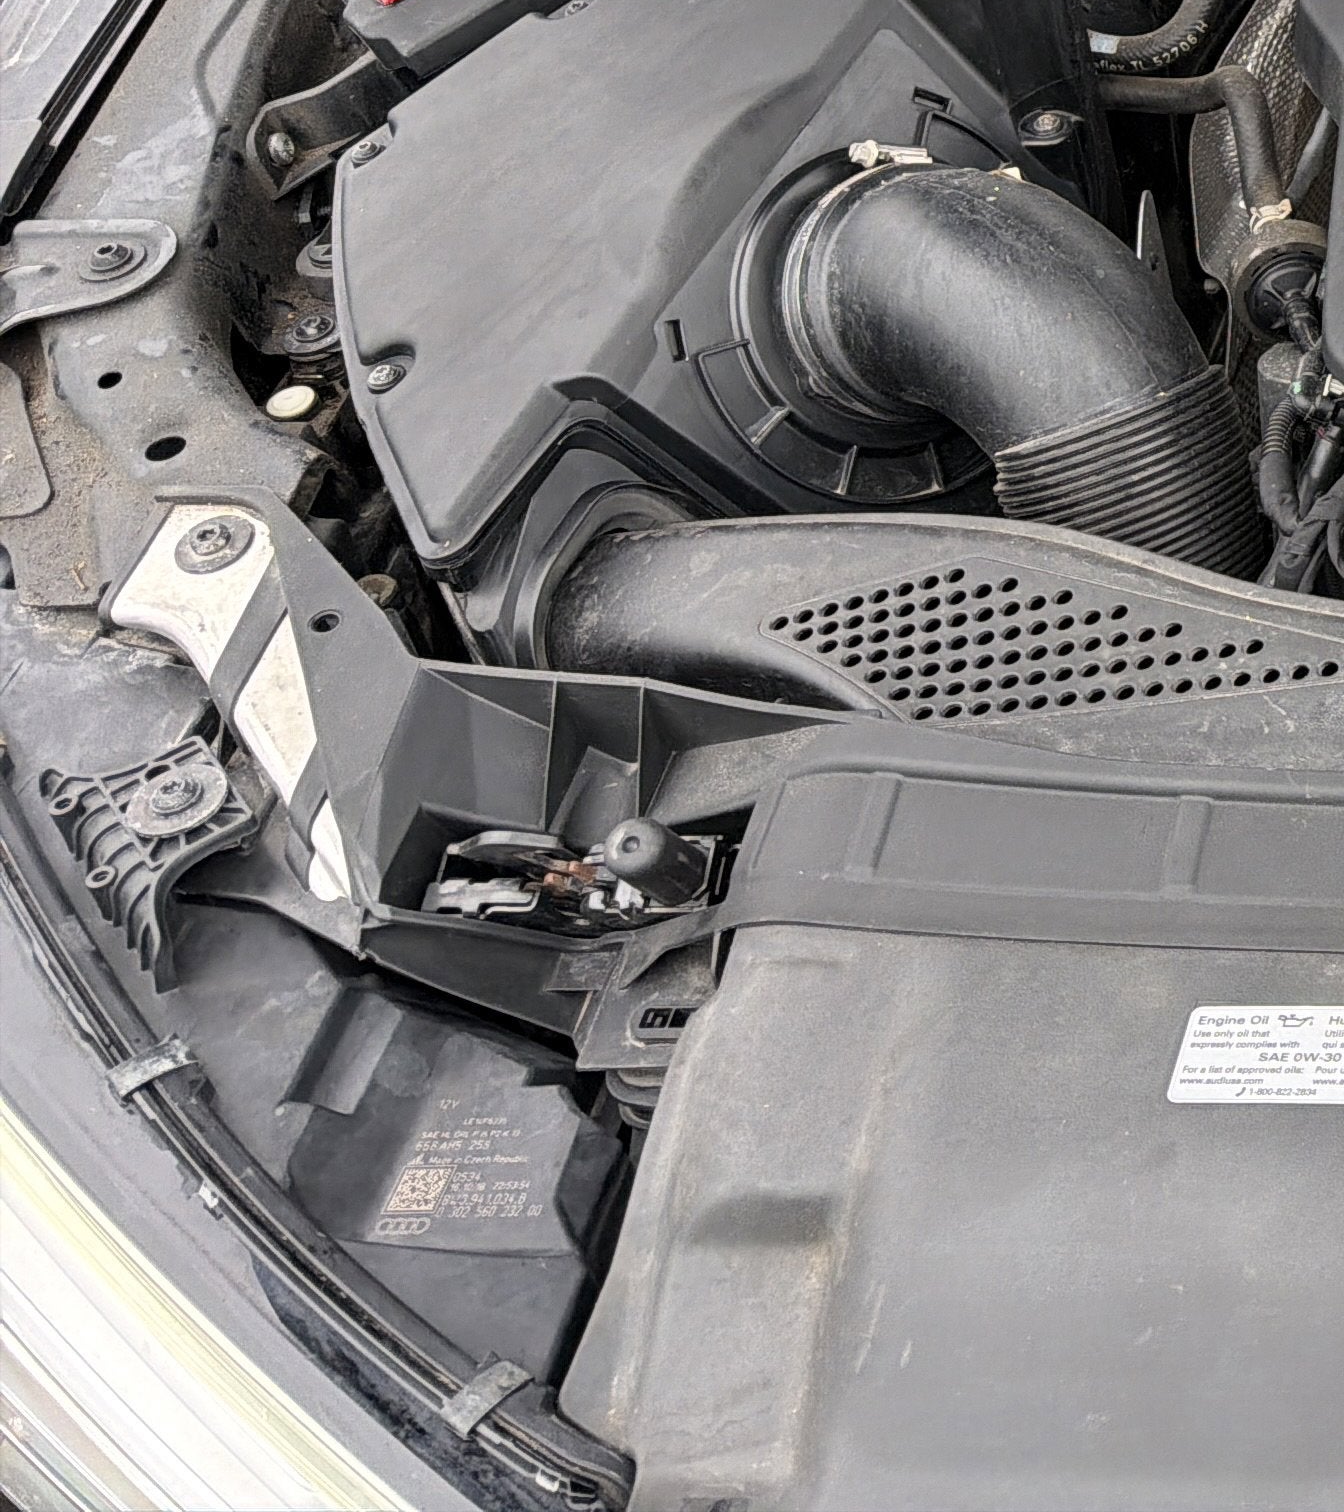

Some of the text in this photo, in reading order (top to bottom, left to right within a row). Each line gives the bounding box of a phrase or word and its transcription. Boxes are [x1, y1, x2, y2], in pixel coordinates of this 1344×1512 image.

[1152, 34, 1198, 67] 52706
[1198, 1015, 1270, 1027] Engine Oil
[1193, 1029, 1271, 1040] Use only oil that
[1190, 1040, 1300, 1050] expressly complies with
[1322, 1041, 1338, 1050] qui
[1257, 1052, 1290, 1062] SAE
[1293, 1052, 1343, 1062] 0W-30
[1182, 1065, 1198, 1074] For
[1208, 1065, 1223, 1074] list
[1224, 1065, 1236, 1074] of
[1237, 1065, 1282, 1076] approved
[1314, 1066, 1338, 1074] Pour
[1179, 1077, 1264, 1085] www.audiusa.com
[439, 1098, 460, 1109] 12V
[428, 1154, 529, 1165] Made Czech Republic
[452, 1172, 481, 1183] 0534
[448, 1206, 471, 1218] 302
[473, 1206, 497, 1218] 560
